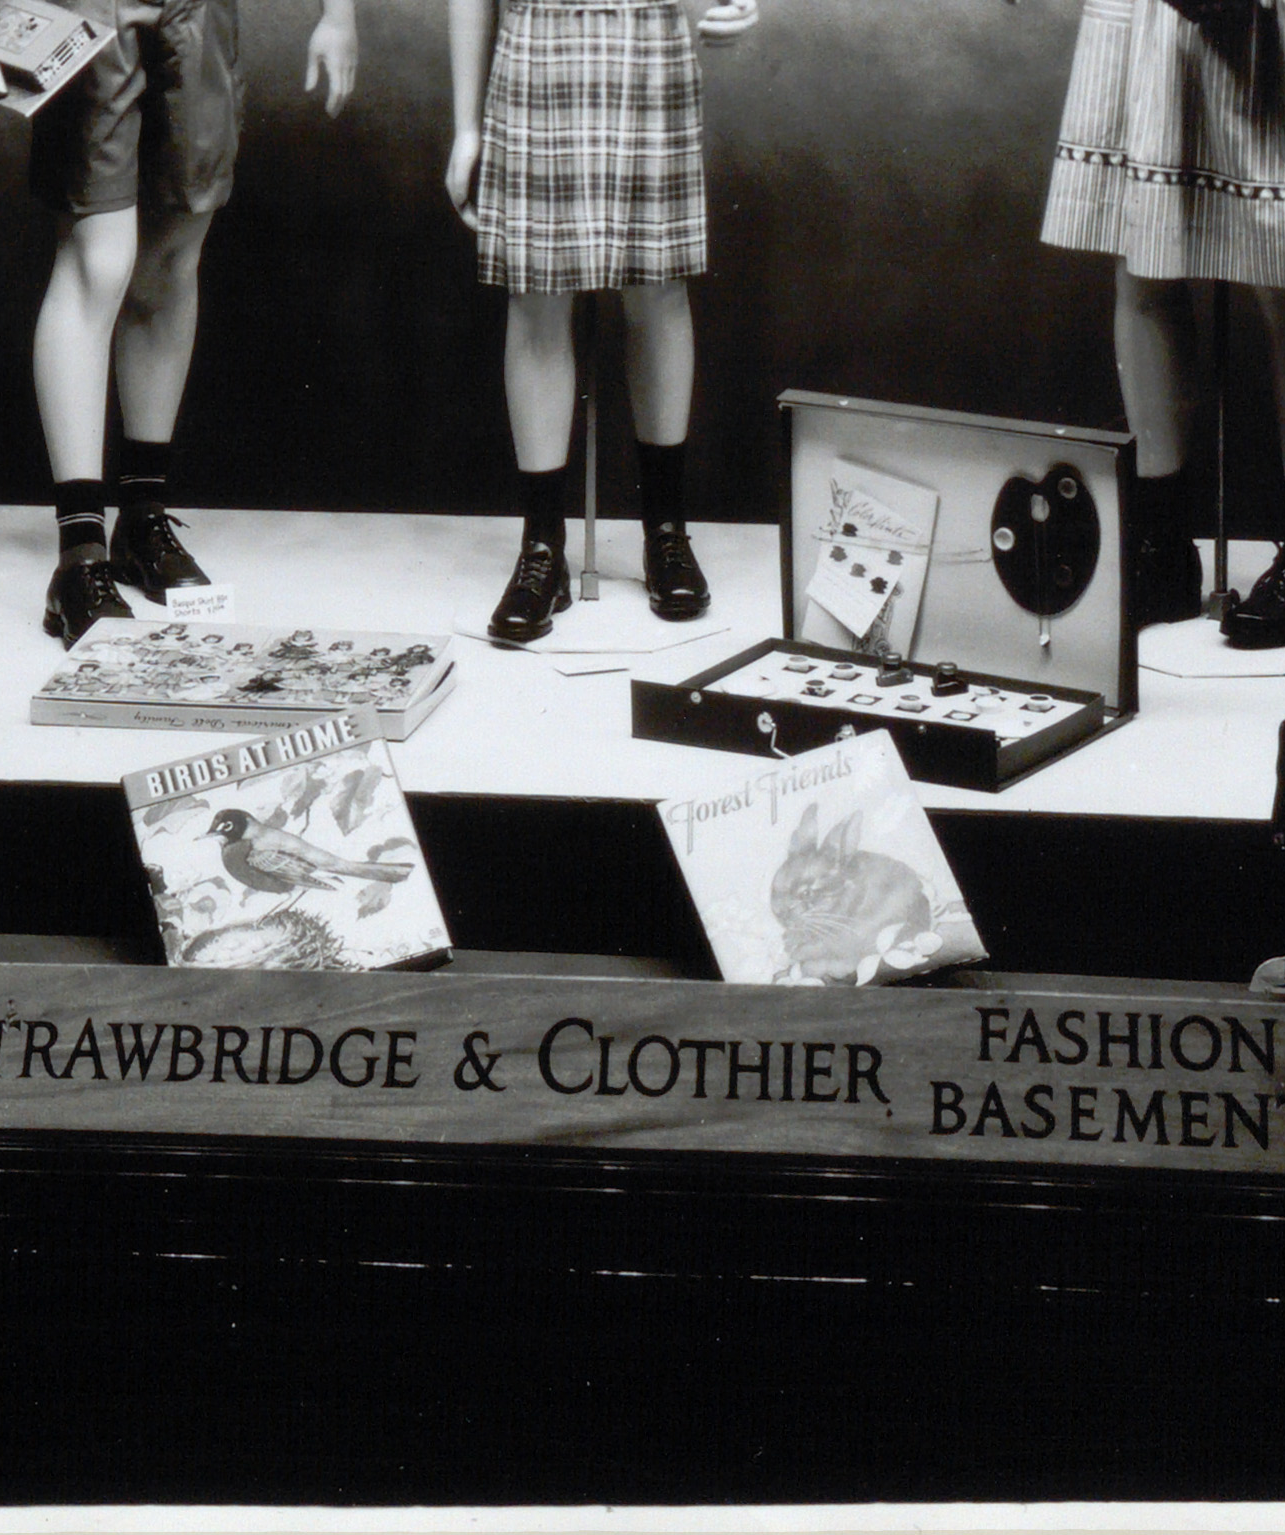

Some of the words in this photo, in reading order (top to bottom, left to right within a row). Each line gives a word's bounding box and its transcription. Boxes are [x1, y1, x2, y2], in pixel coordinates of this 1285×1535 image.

[145, 753, 231, 799] BIRDS
[237, 739, 271, 773] AT
[276, 714, 357, 761] HOME
[666, 780, 753, 856] Forest
[756, 750, 853, 826] Friends
[453, 1030, 507, 1092] &
[537, 1016, 892, 1104] CLOTHIER
[974, 1006, 1279, 1075] FASHION
